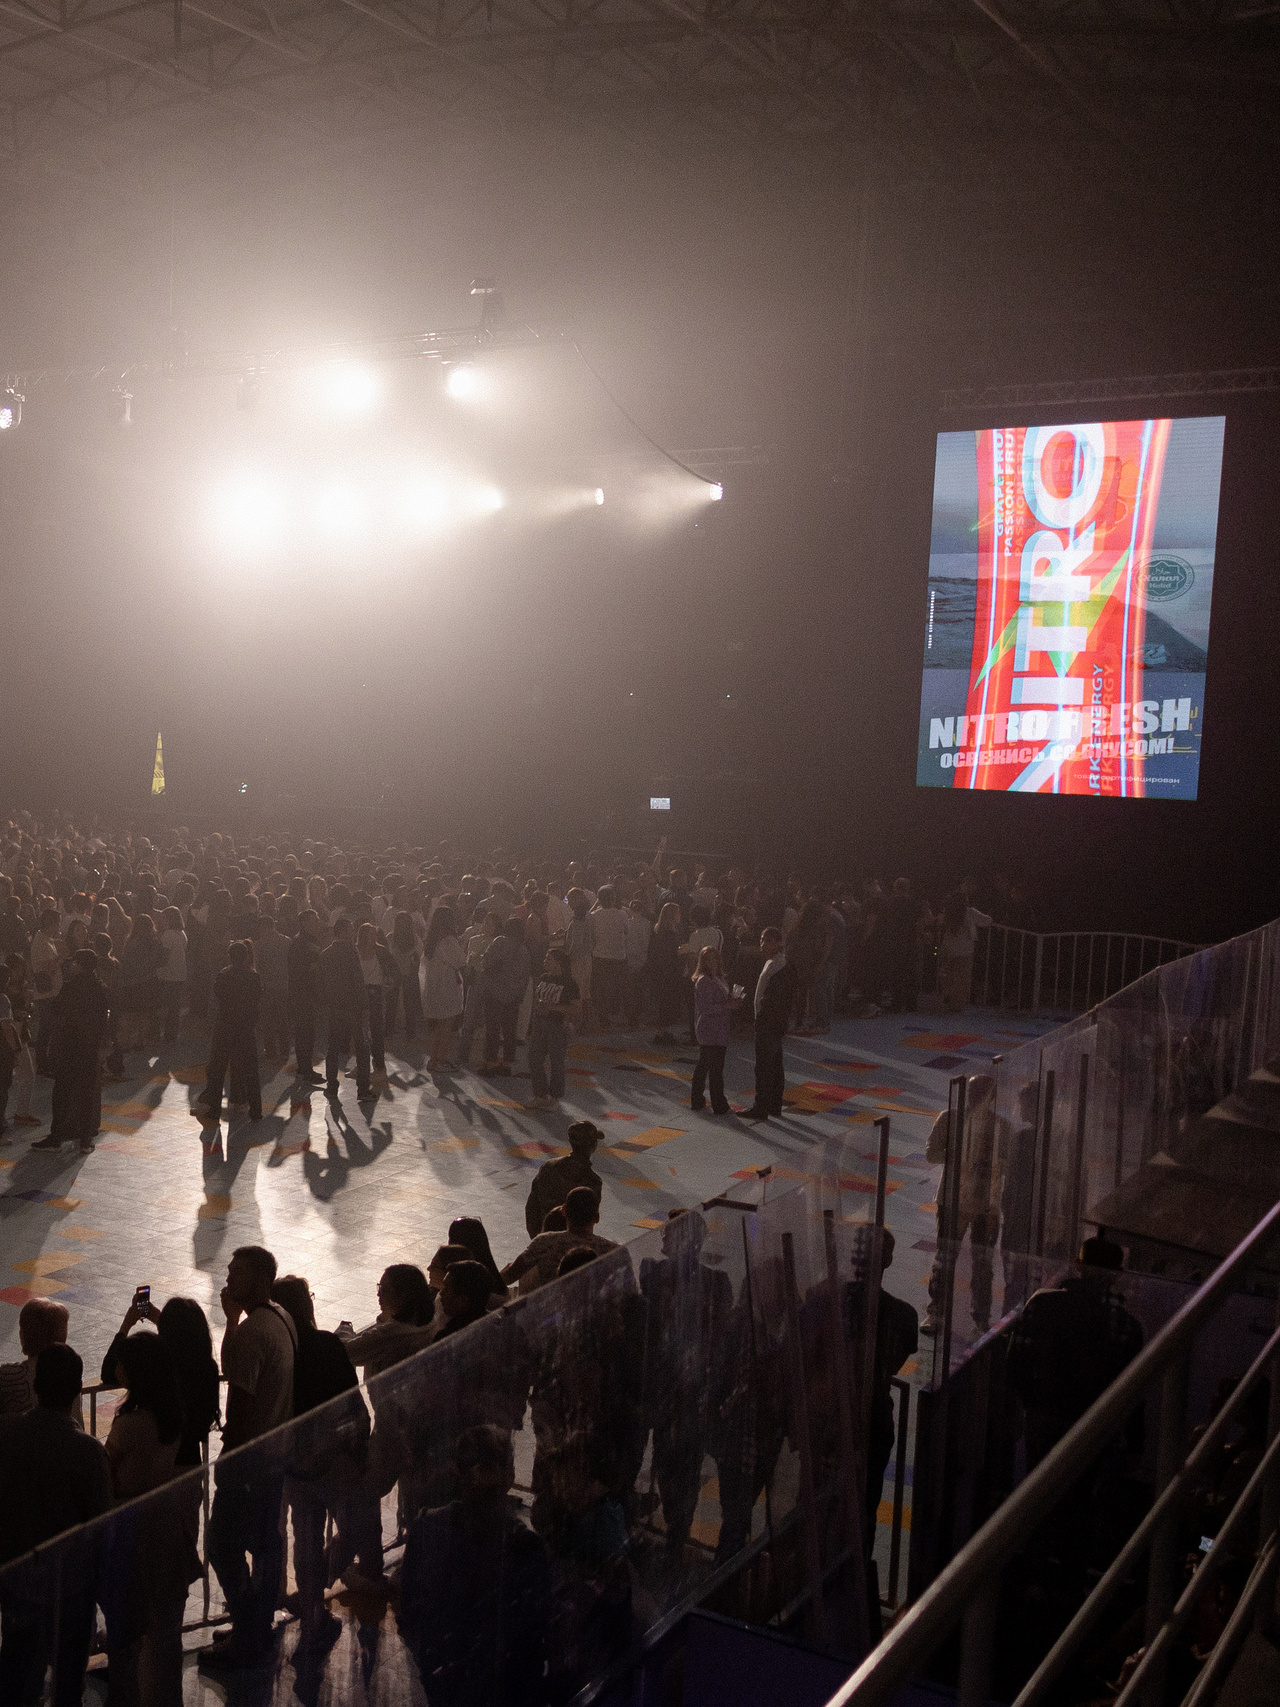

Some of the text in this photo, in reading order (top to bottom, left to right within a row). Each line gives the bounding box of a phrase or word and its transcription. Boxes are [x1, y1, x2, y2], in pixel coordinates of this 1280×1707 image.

[1004, 481, 1014, 557] PASSION
[928, 709, 1049, 749] NITRO
[939, 746, 1046, 769] ОСВЕЖИСЬ
